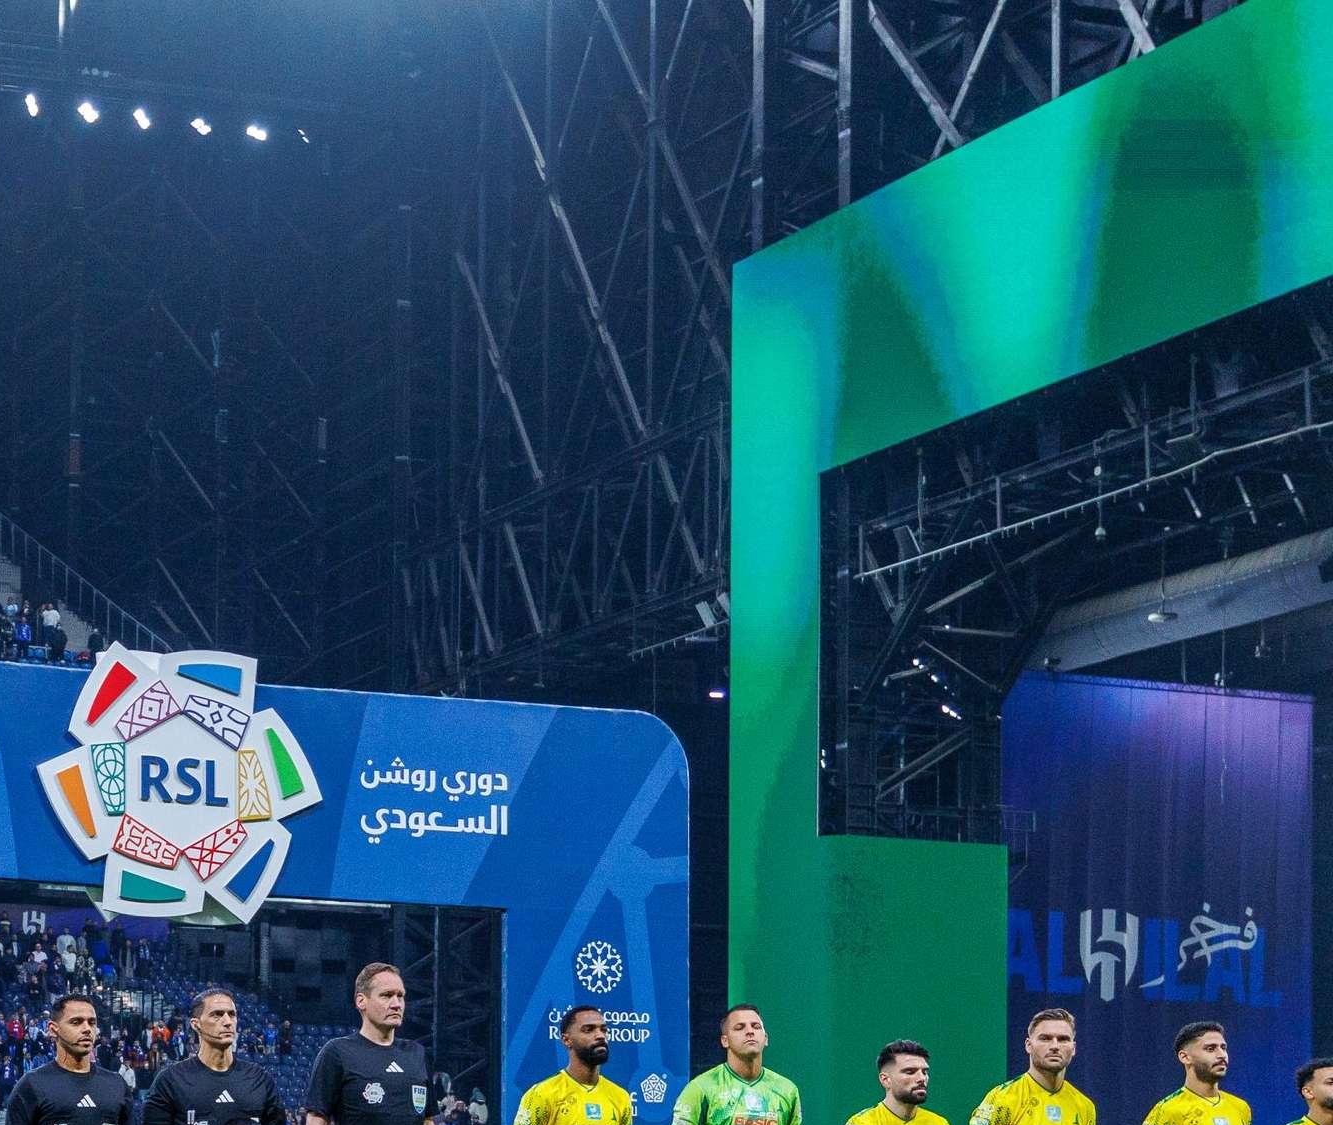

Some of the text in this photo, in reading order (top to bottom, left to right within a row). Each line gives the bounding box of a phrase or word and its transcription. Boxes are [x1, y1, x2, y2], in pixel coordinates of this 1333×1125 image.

[139, 754, 229, 808] RSL
[359, 756, 509, 802] دوري روشن
[359, 804, 509, 845] السعودي
